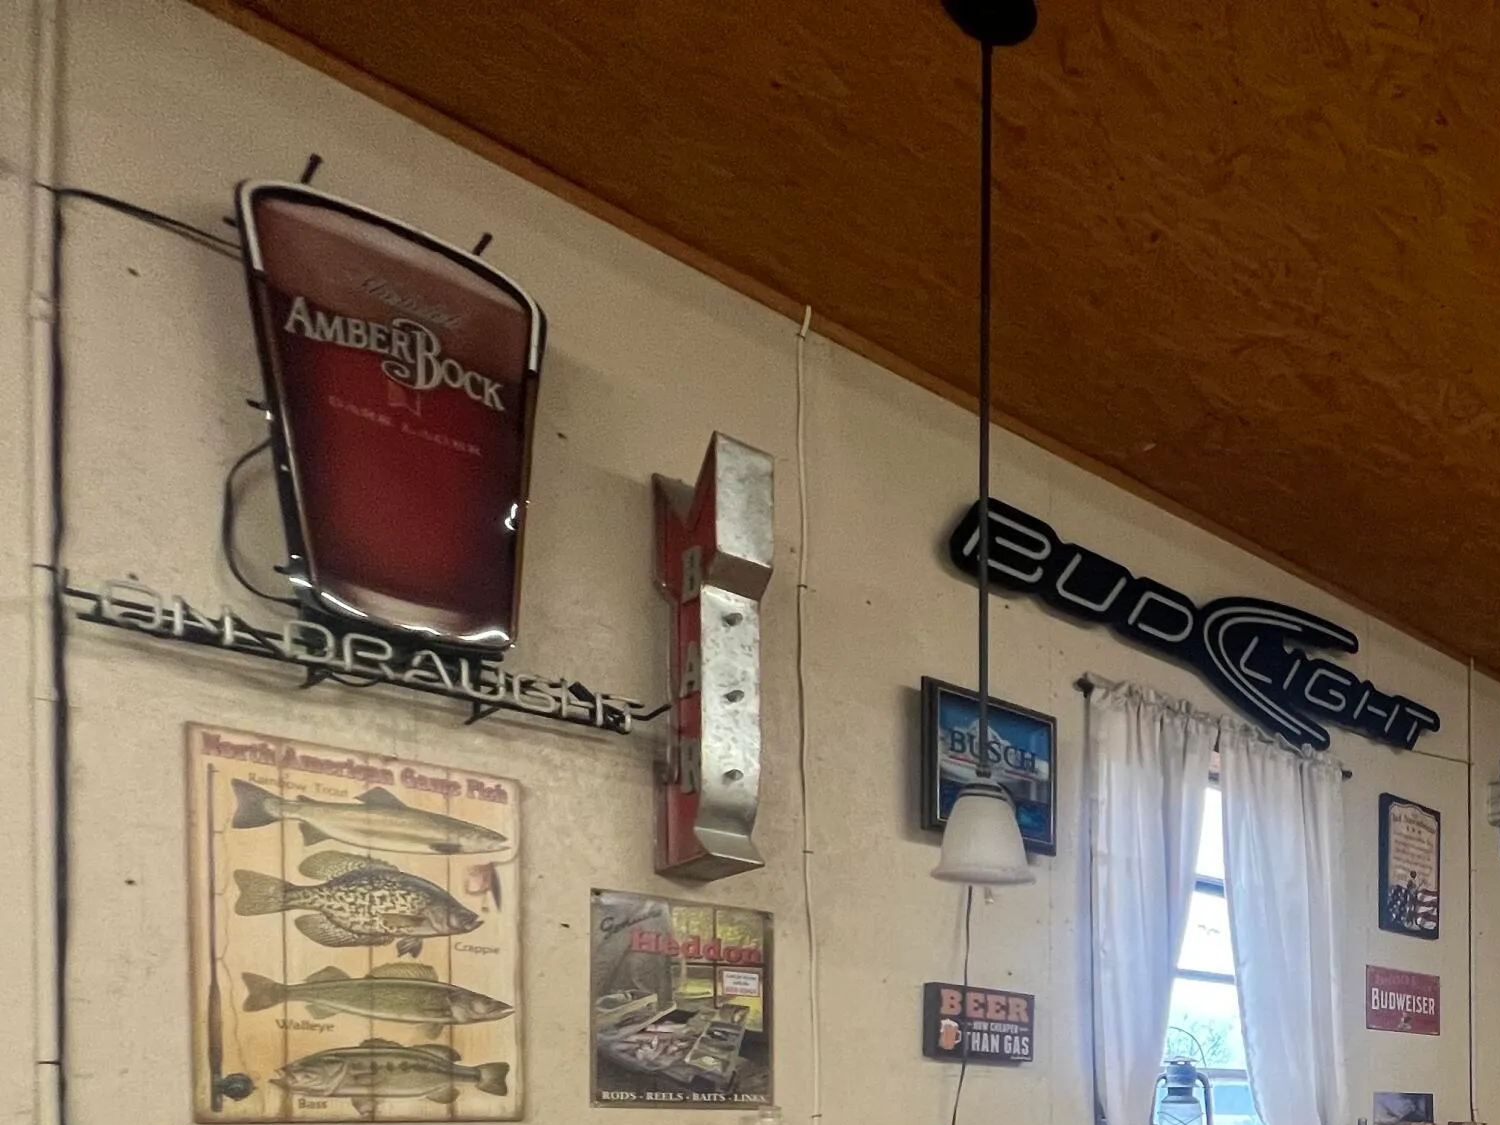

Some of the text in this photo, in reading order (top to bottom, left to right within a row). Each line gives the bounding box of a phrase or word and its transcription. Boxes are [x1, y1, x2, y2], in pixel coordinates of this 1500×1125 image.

[284, 296, 415, 363] AMBER
[381, 318, 504, 411] BOCK
[962, 511, 1438, 742] BUD LIGHT
[283, 620, 645, 732] DRAUGHT
[201, 731, 277, 766] North
[950, 729, 1037, 774] BUSCH
[629, 929, 763, 964] Heddon
[941, 988, 1030, 1022] BEER
[1371, 987, 1436, 1015] BUDWEISER
[275, 1019, 335, 1033] Walleye
[1003, 1035, 1030, 1056] GAS
[298, 1098, 328, 1110] Bass
[602, 1090, 637, 1101] RODS
[646, 1091, 684, 1102] REELS
[692, 1092, 726, 1102] BAITS
